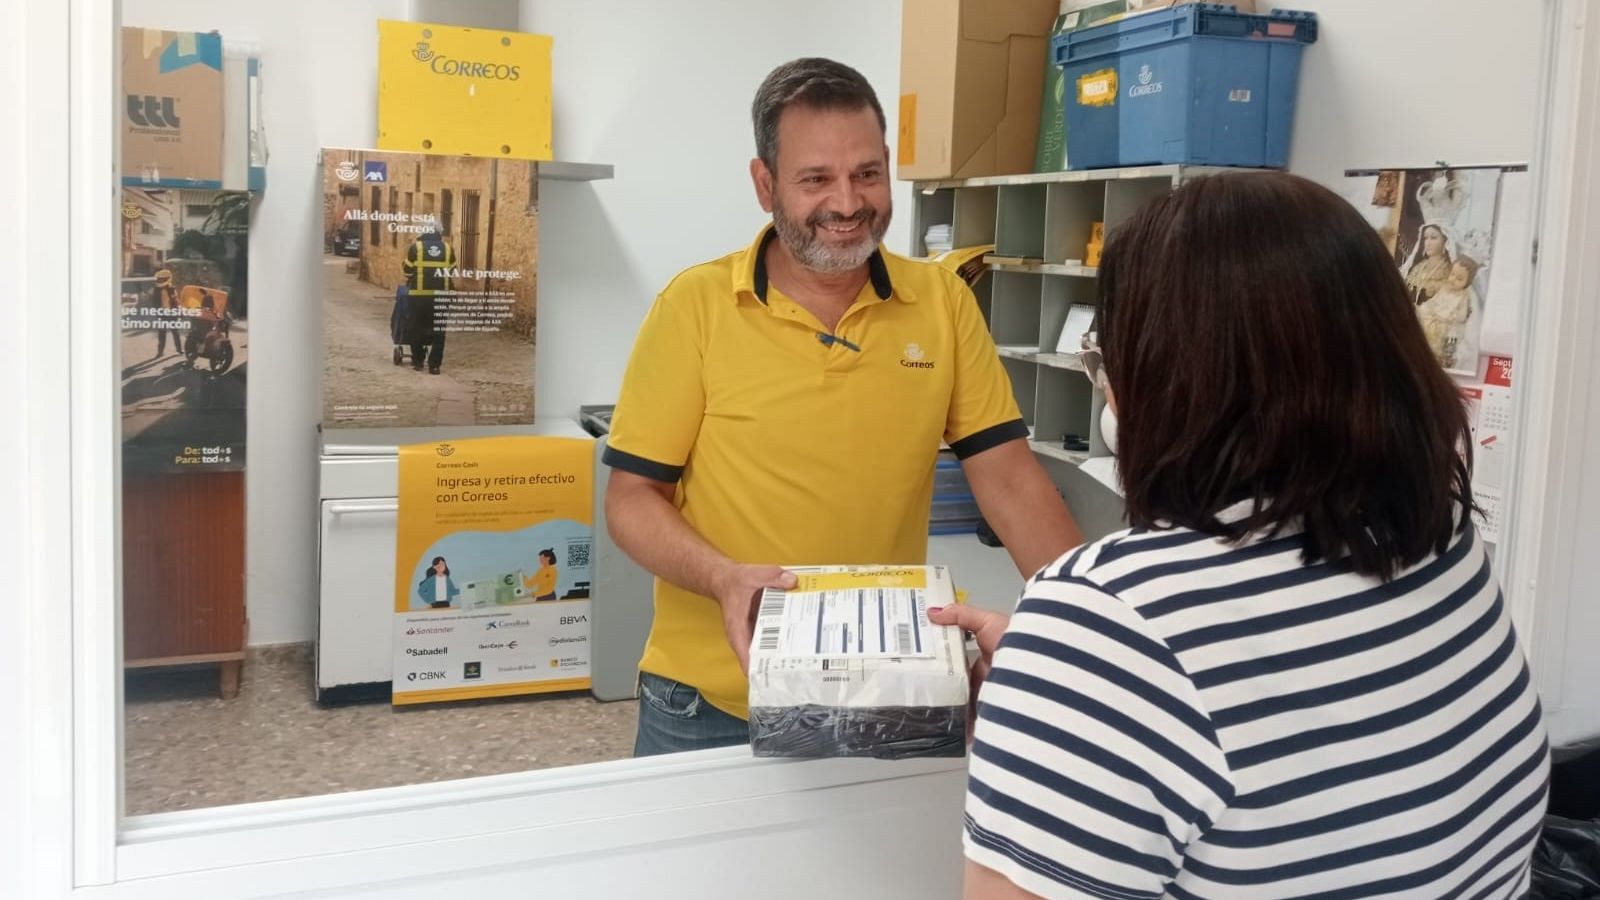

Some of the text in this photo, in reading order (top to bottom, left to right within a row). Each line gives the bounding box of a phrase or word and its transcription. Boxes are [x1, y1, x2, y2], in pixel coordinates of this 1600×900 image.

[430, 55, 520, 81] CORREOS
[364, 172, 384, 180] AXA
[344, 210, 435, 223] Allá donde está
[388, 222, 436, 234] Correos
[434, 268, 522, 280] AXA te protege.
[141, 305, 202, 316] necesites
[152, 317, 192, 329] rincón
[900, 360, 935, 368] Correos
[185, 446, 200, 454] De:
[176, 456, 200, 464] Para:
[436, 472, 575, 490] Ingresa y retira efectivo
[436, 491, 508, 503] con Correos
[560, 615, 587, 625] BBVA
[416, 626, 454, 635] Santander
[412, 647, 448, 656] Sabadell
[419, 672, 446, 680] CBNK
